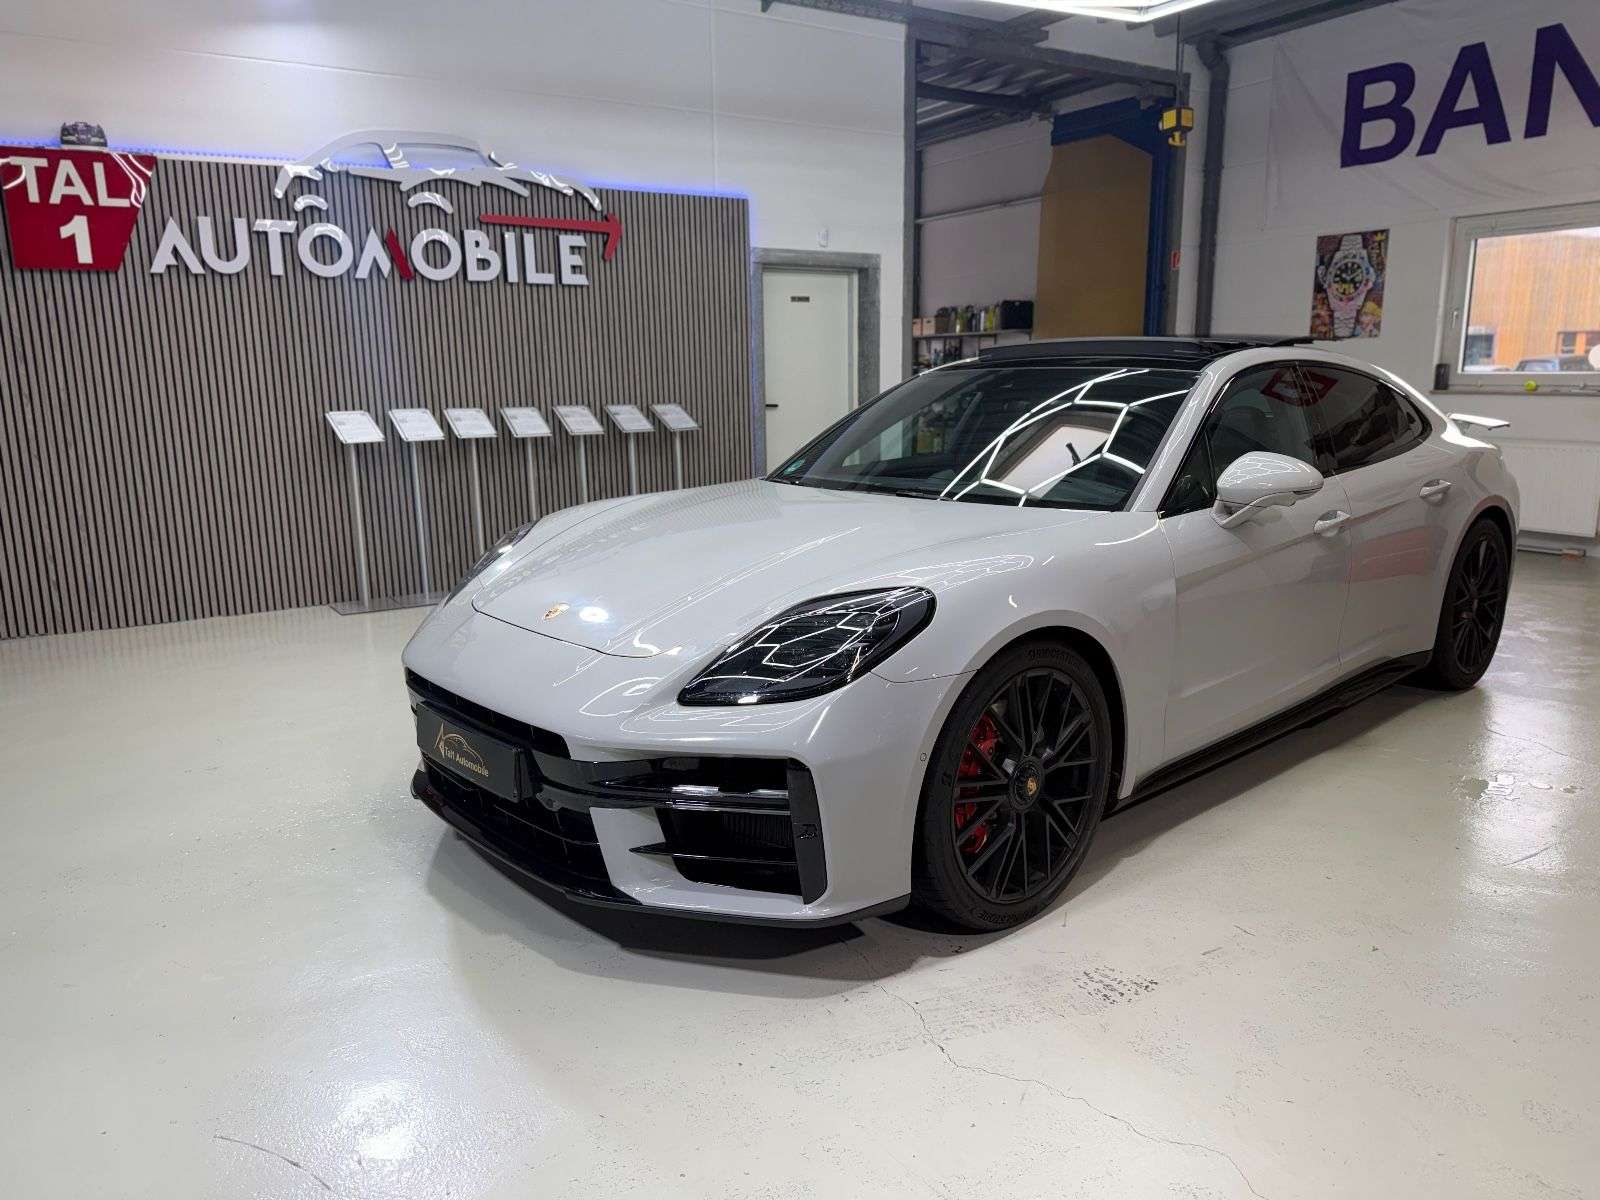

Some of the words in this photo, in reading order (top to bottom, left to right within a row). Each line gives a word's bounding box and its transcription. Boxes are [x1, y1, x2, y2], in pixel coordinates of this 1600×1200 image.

[9, 155, 131, 208] TAL
[59, 214, 93, 265] 1
[150, 215, 590, 287] AUTOMOBILE
[456, 754, 489, 777] Automobile
